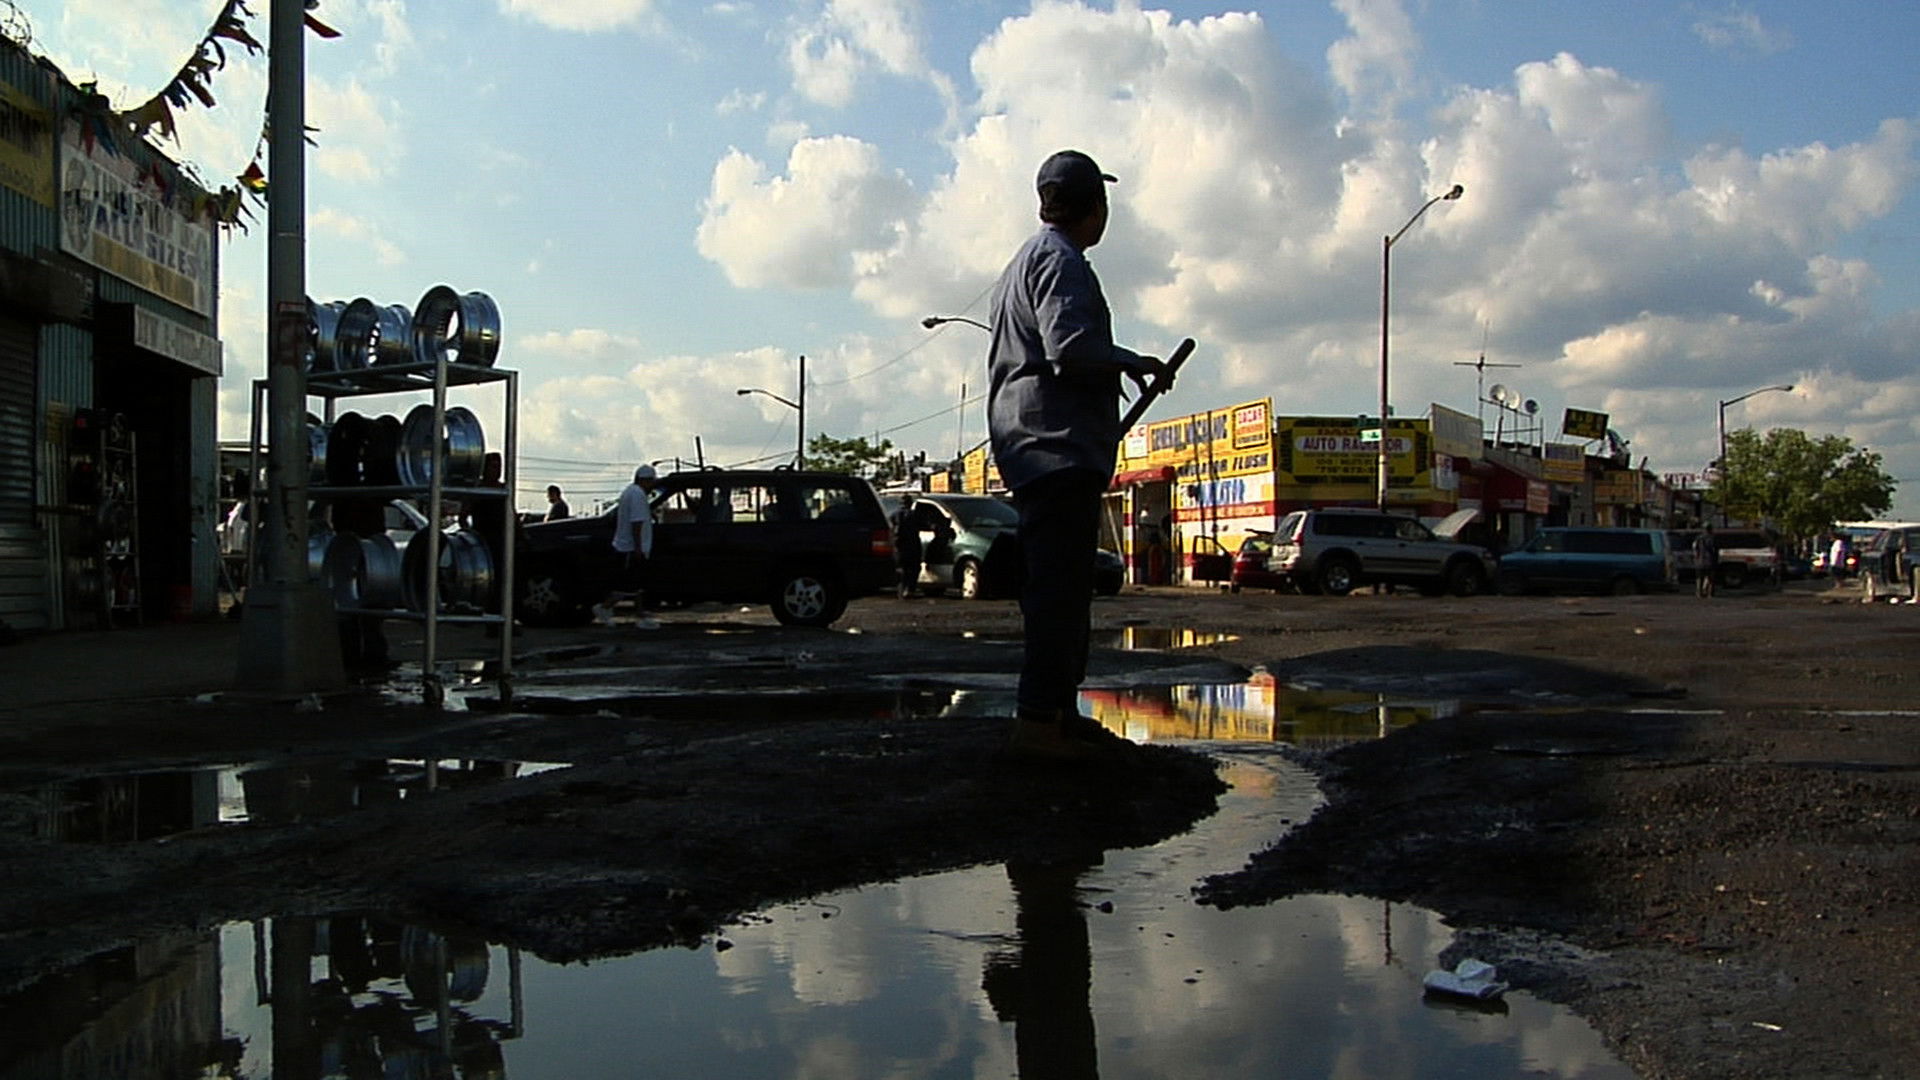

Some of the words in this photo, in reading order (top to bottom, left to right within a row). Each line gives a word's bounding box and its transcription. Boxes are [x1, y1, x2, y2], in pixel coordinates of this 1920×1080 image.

[146, 233, 198, 281] SIZES
[1303, 438, 1336, 451] AUTO
[1233, 453, 1268, 471] FLUSH
